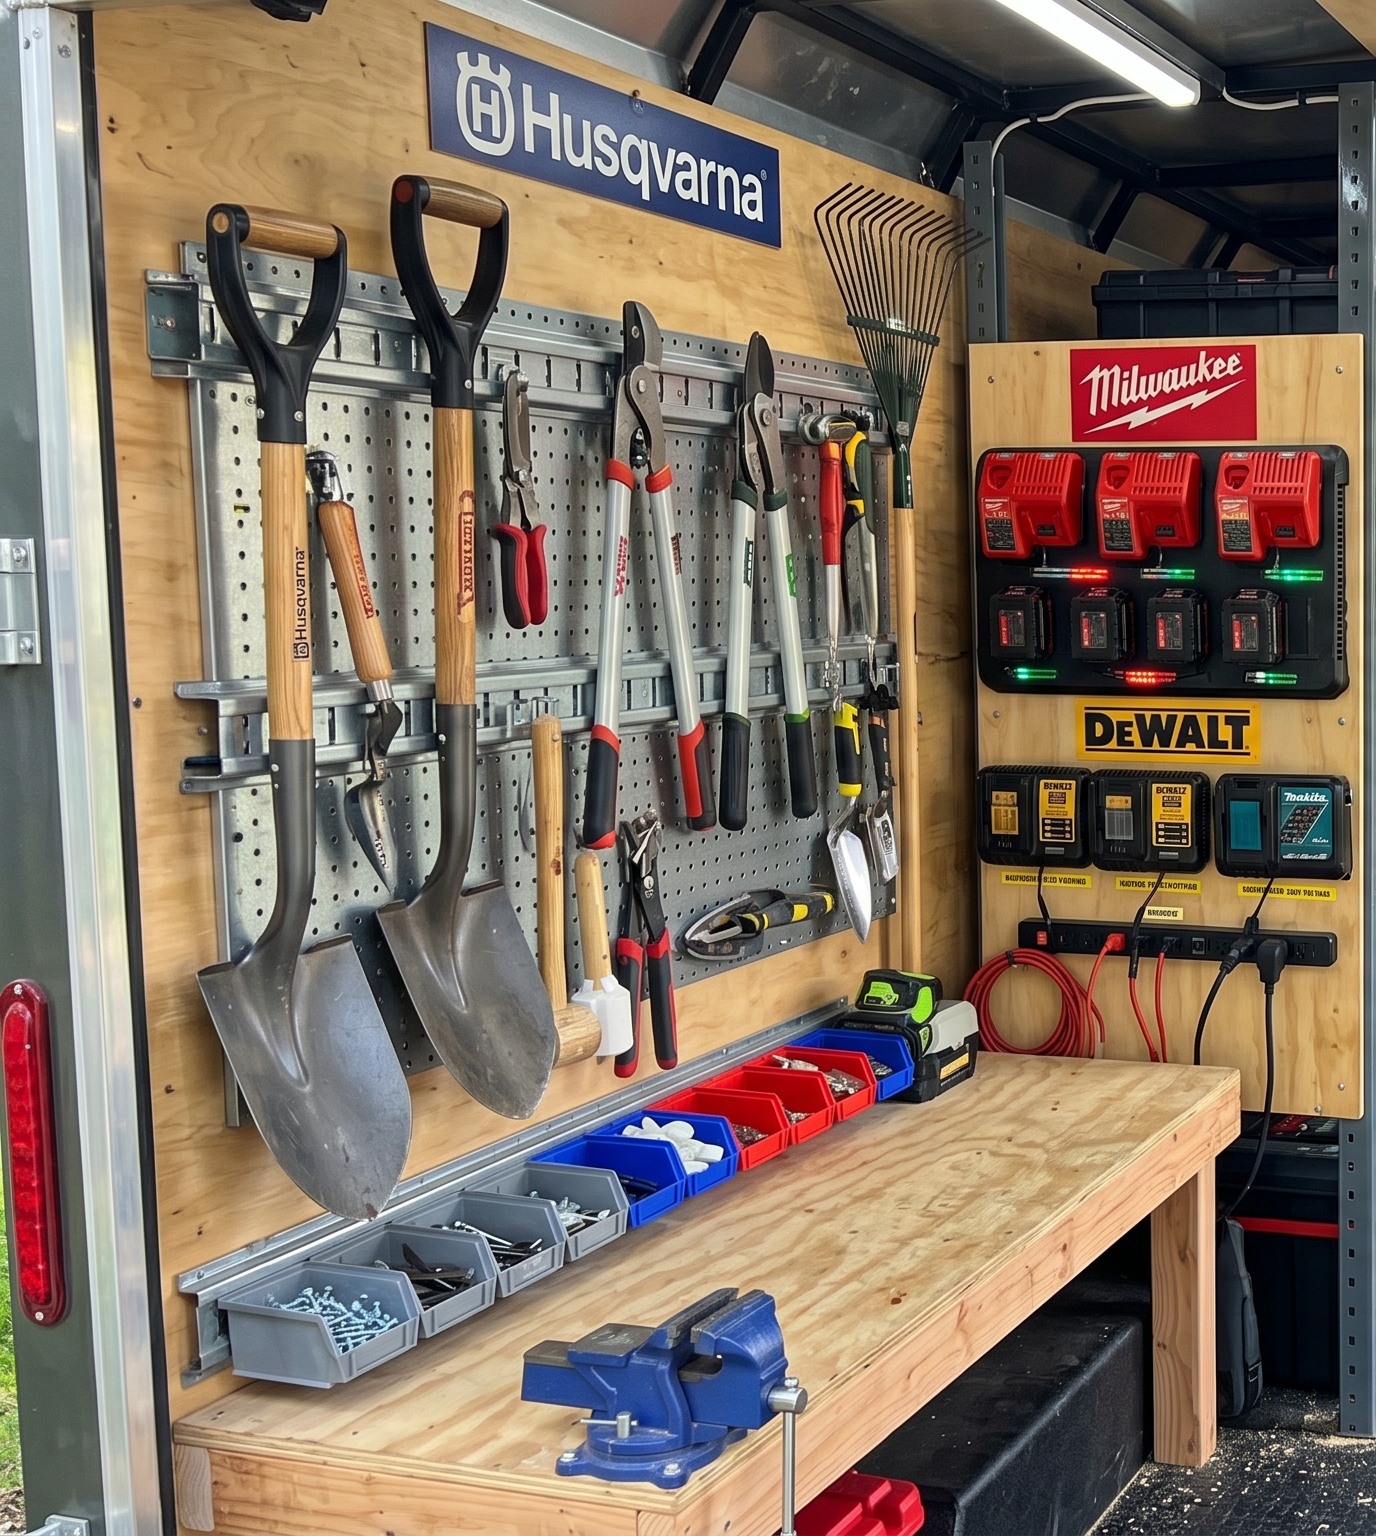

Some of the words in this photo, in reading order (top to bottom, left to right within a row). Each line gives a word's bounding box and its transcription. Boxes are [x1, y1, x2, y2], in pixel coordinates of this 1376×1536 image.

[522, 82, 765, 223] Husqvarna
[1079, 350, 1244, 417] Milwaukee
[294, 549, 307, 641] Husqvarna
